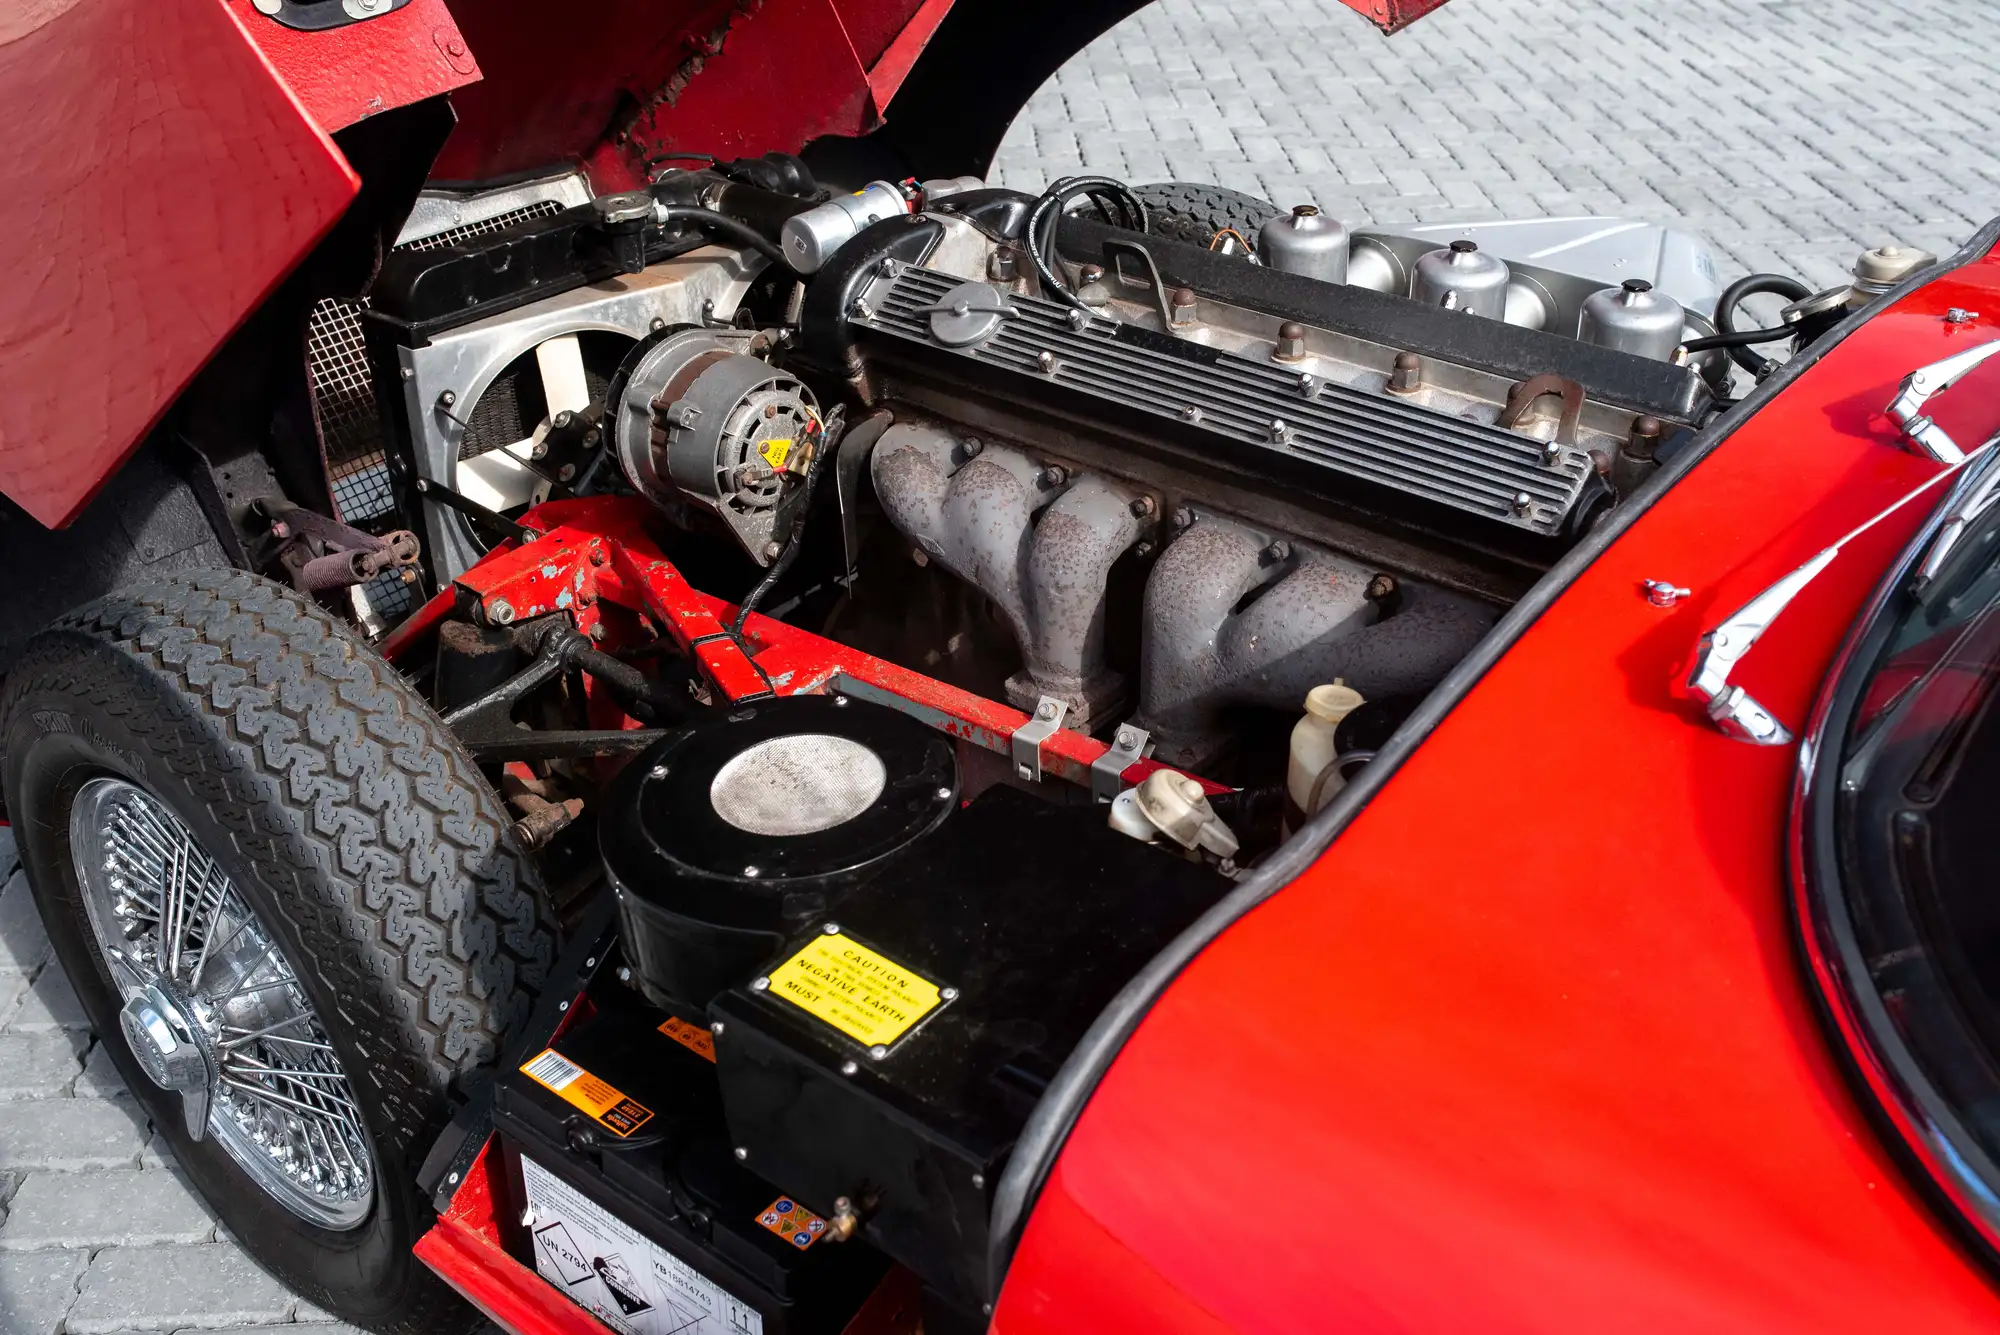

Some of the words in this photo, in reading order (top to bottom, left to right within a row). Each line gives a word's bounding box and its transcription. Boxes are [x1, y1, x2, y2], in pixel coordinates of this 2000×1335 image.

[1036, 257, 1061, 288] MAGNECOR
[843, 950, 909, 988] CAUTION
[785, 980, 822, 1003] MUST
[796, 958, 857, 996] NEGATIVE
[863, 994, 906, 1022] EARTH
[541, 1234, 560, 1254] UN
[561, 1248, 589, 1274] 2794
[605, 1276, 641, 1306] CORROSIVE
